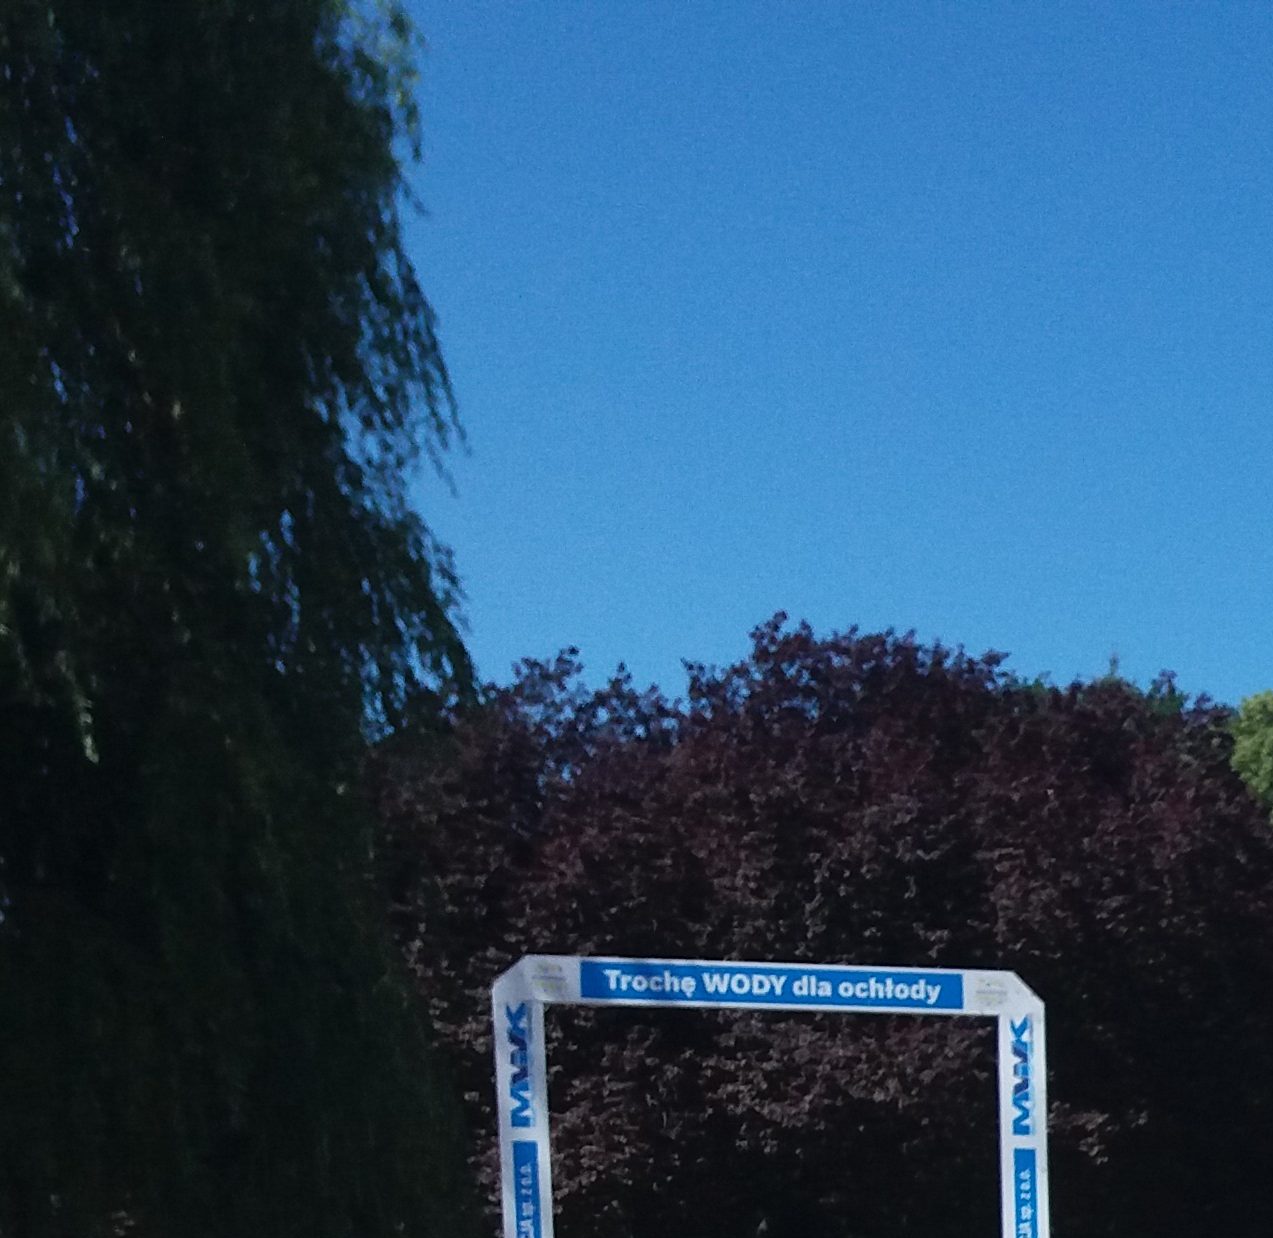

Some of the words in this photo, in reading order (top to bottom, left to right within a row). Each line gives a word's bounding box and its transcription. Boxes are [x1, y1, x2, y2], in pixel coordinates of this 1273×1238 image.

[603, 968, 696, 998] Trochę
[702, 972, 787, 997] WODY
[794, 976, 831, 998] dla
[838, 980, 941, 1005] ochłody
[506, 1003, 532, 1128] MWK
[1010, 1015, 1031, 1136] MWK
